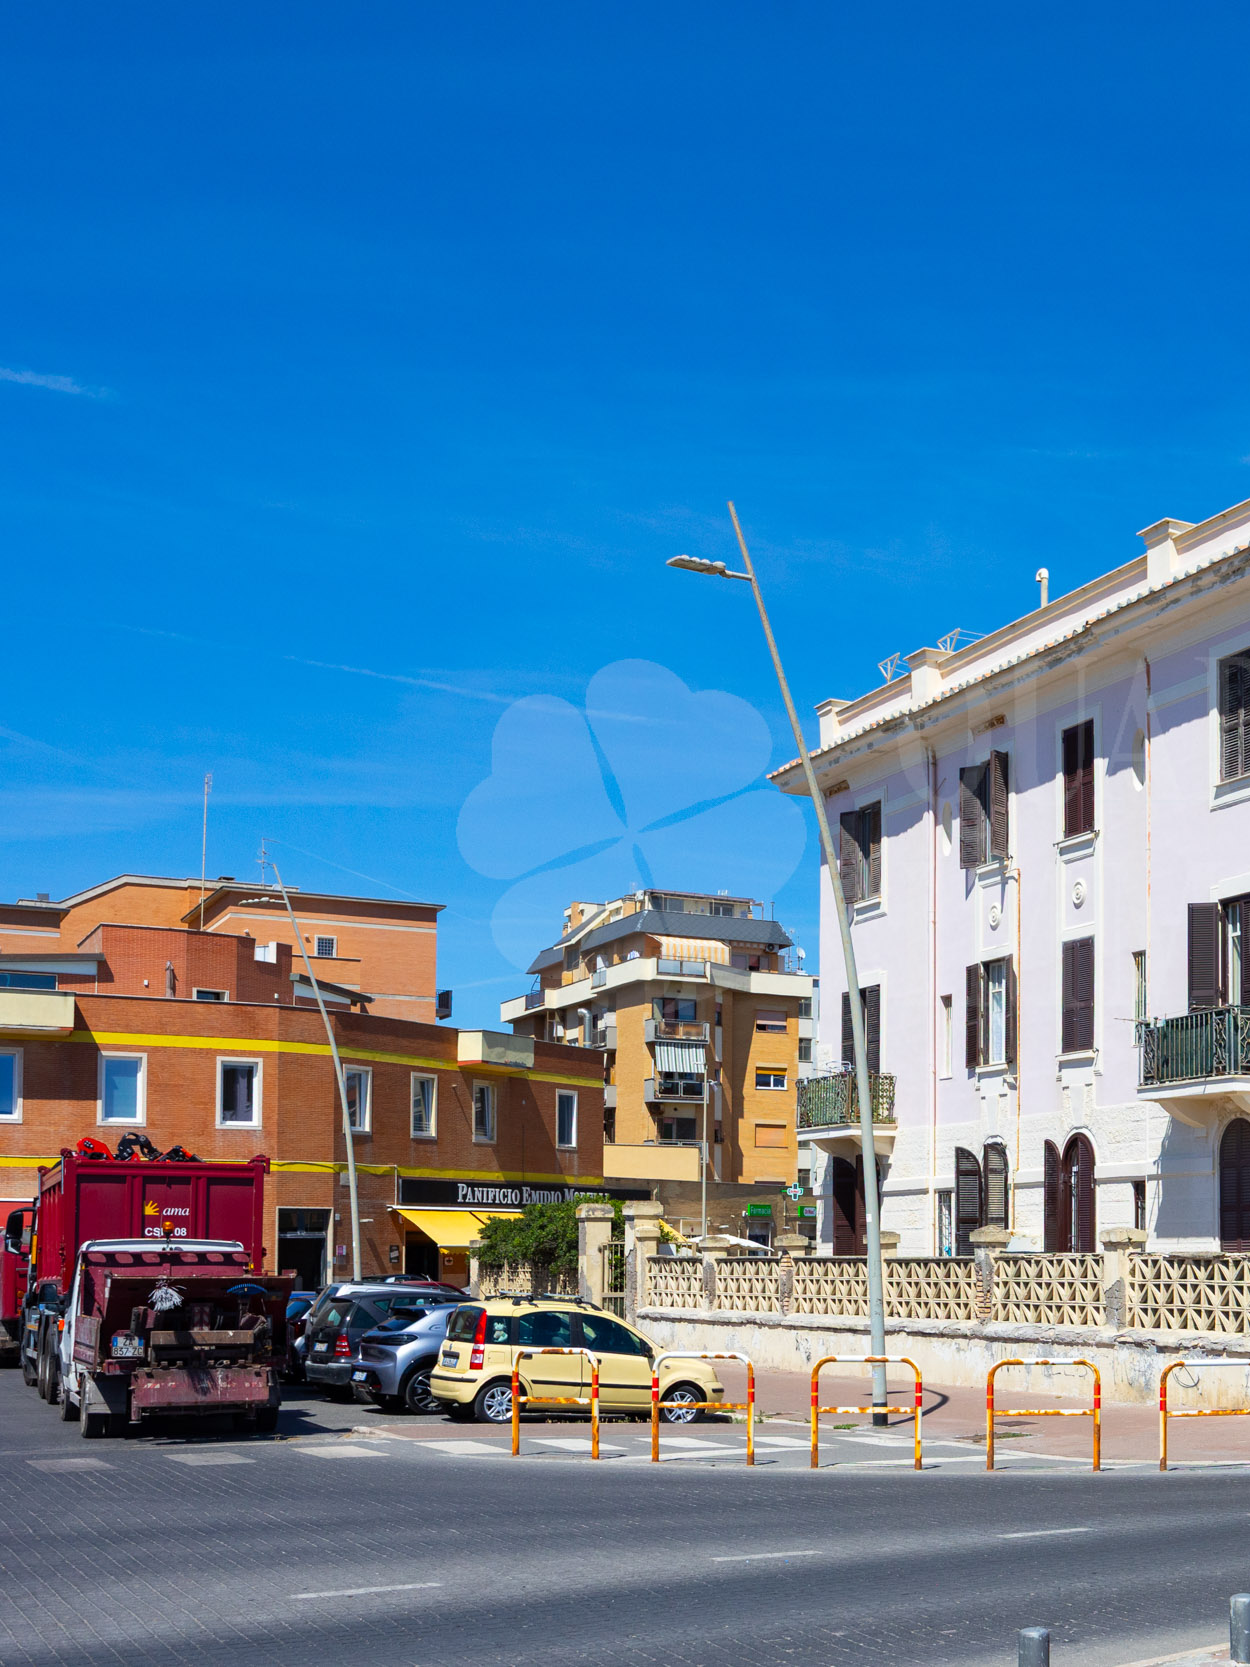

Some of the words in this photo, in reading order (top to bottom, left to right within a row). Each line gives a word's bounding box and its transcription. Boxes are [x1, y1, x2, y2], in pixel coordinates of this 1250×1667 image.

[457, 1184, 520, 1204] PANIFICIO
[521, 1186, 562, 1205] EMIDIO
[162, 1207, 190, 1216] ama
